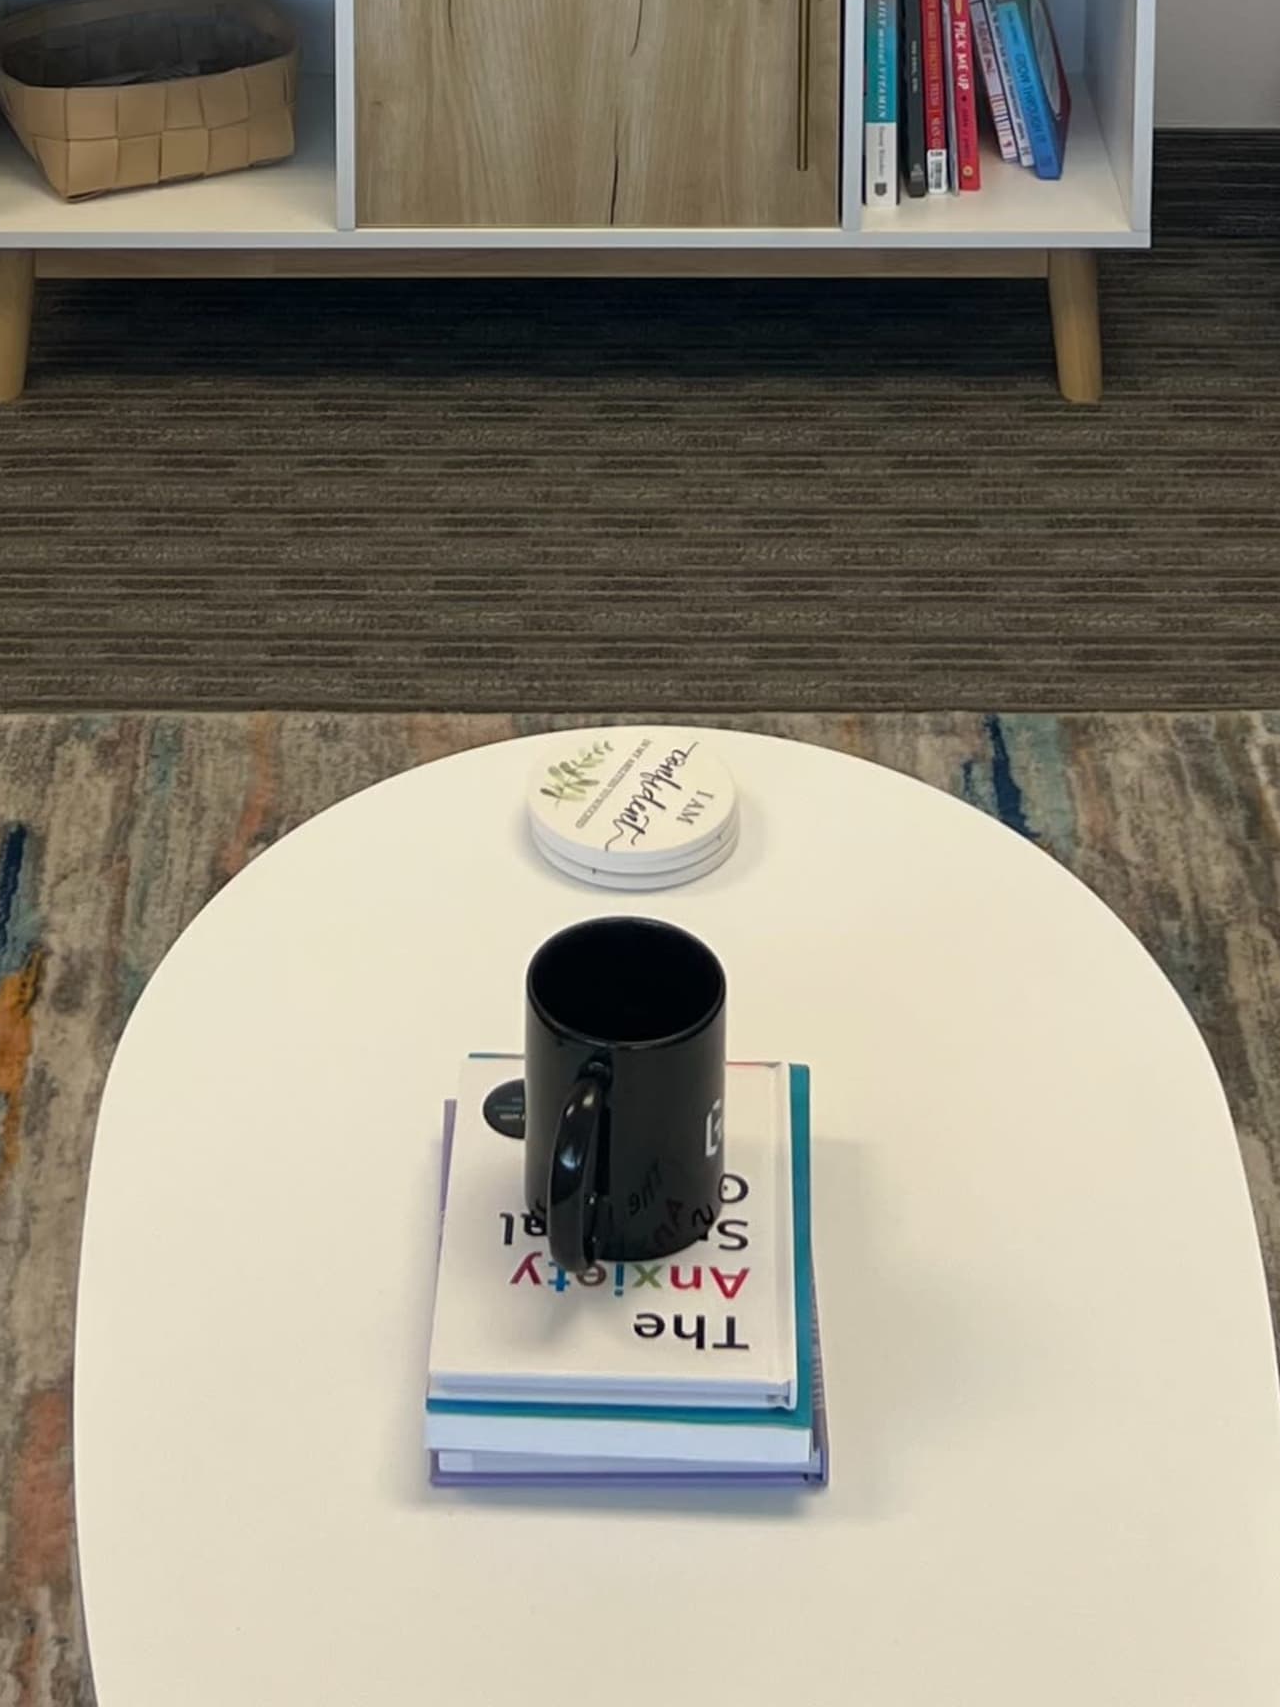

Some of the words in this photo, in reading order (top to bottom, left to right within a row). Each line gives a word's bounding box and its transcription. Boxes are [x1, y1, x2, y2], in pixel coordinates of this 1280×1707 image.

[877, 28, 886, 64] mental
[954, 20, 967, 48] PICK
[956, 53, 968, 70] ME
[878, 67, 887, 119] VITAMIN
[957, 74, 969, 90] UP
[605, 741, 700, 853] confident
[696, 790, 715, 801] I
[676, 798, 706, 826] AM
[510, 1251, 750, 1300] Anxiety
[633, 1312, 749, 1350] The
